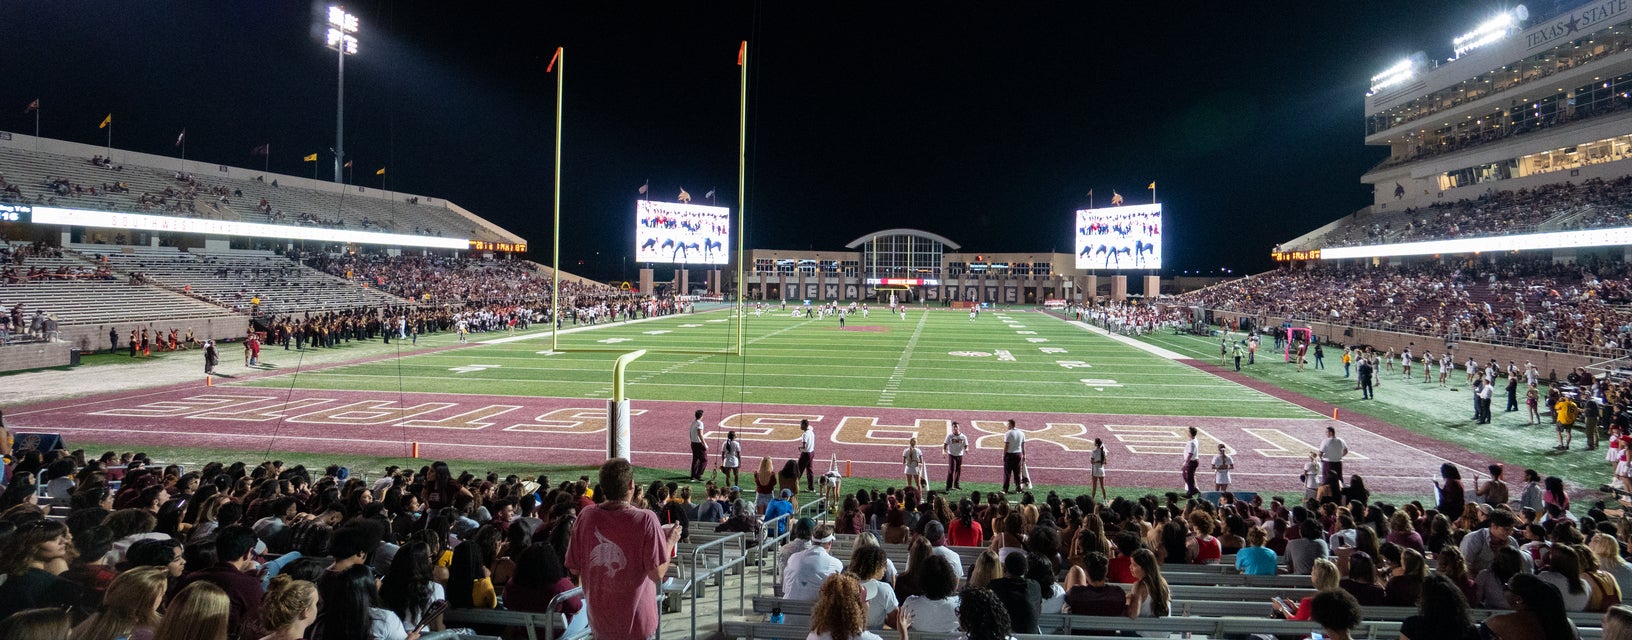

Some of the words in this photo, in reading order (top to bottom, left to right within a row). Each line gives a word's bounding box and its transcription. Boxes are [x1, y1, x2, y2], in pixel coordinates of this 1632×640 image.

[1526, 22, 1564, 47] TEXAS
[1582, 0, 1628, 26] STATE
[111, 214, 195, 231] SOUTHWEST
[787, 284, 877, 299] TEXAS
[927, 284, 1016, 299] STATE
[87, 394, 648, 433] STATE
[703, 412, 1370, 460] TEXAS
